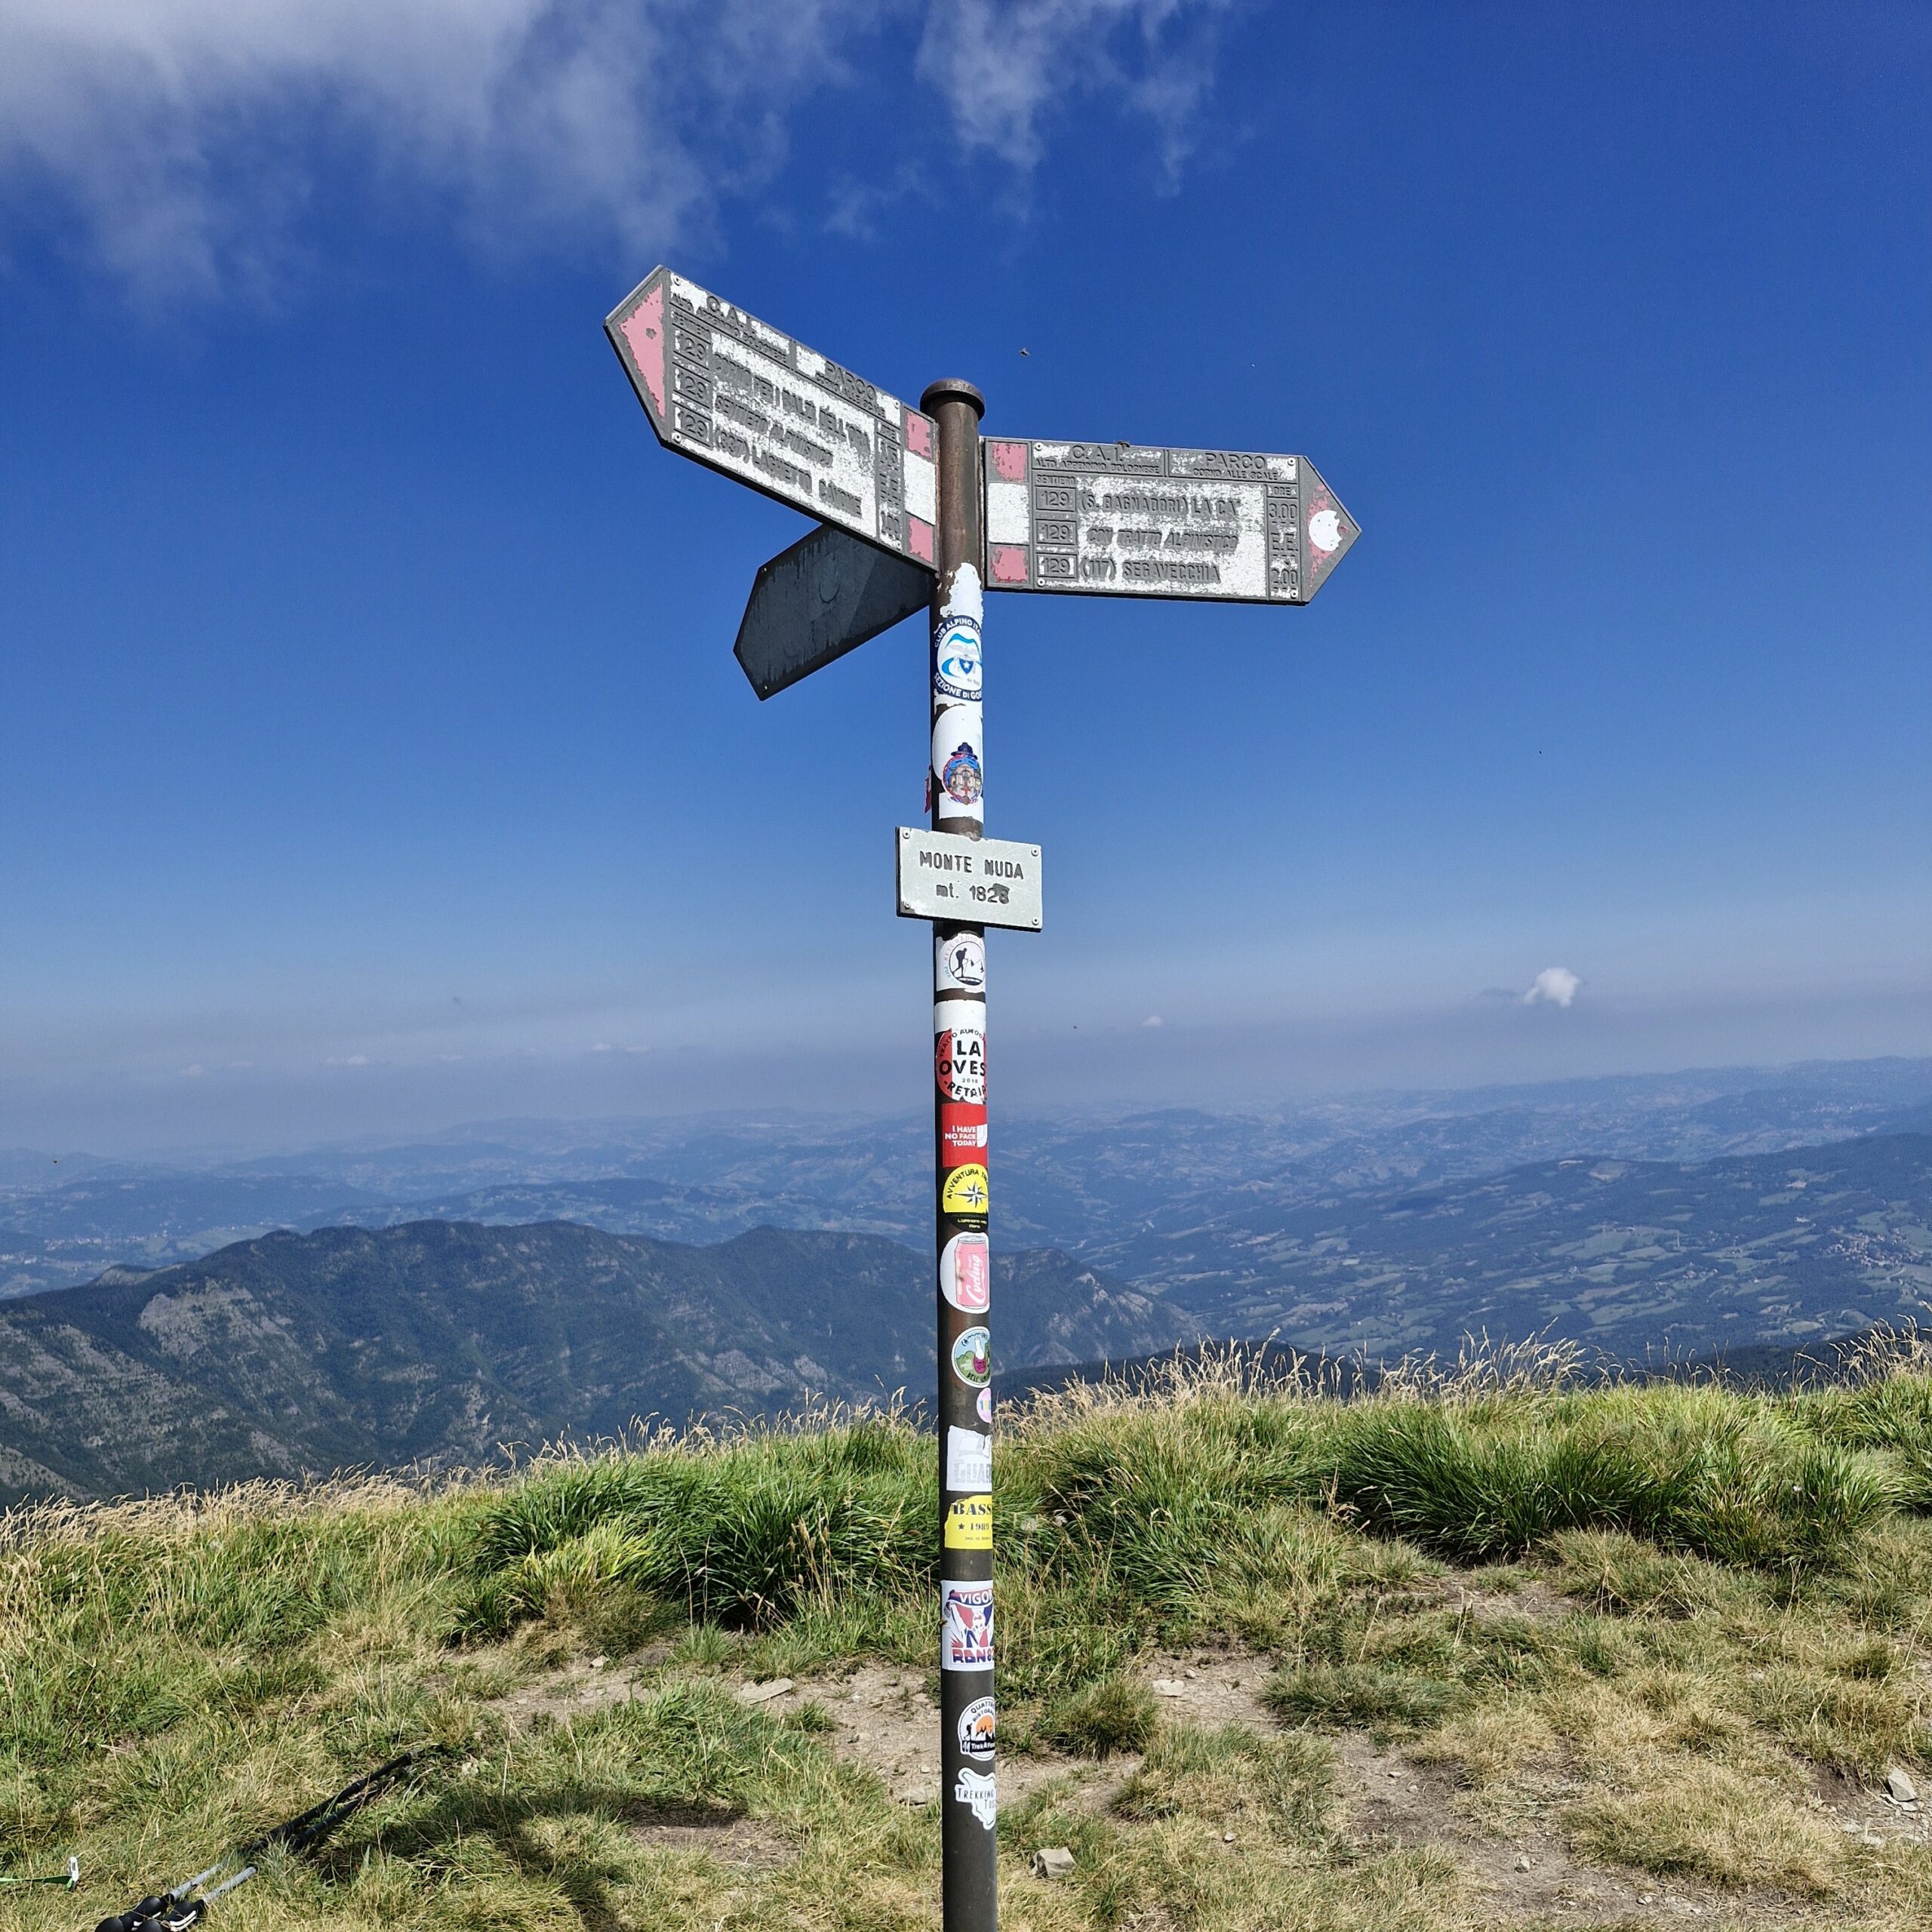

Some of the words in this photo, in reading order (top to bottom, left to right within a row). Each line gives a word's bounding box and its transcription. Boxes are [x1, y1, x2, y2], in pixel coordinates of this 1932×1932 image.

[679, 333, 706, 361] 129
[679, 371, 707, 400] 129
[825, 360, 876, 400] PARCO
[679, 410, 707, 438] 129
[1072, 445, 1124, 463] C.A.I.
[1204, 452, 1267, 469] PARCO
[1036, 458, 1057, 469] ALTO
[1061, 460, 1107, 472] APPENNINO
[1110, 463, 1160, 474] BOLOGNESE
[1192, 467, 1222, 478] CORNO
[1226, 469, 1246, 479] ALLE
[1251, 470, 1279, 481] SCALE
[1036, 474, 1076, 488] SENTIERO
[1041, 490, 1070, 507] 129
[1273, 486, 1292, 497] ORE
[1268, 502, 1298, 521] 3.00
[1041, 523, 1071, 541] 129
[1088, 528, 1114, 545] CON
[1117, 529, 1163, 546] TRATTO
[1164, 532, 1239, 550] ALPINISTICO
[1043, 557, 1071, 574] 129
[1122, 561, 1221, 585] SEGAVECCHIA
[934, 627, 947, 648] CLUB
[946, 617, 973, 630] ALPINO
[934, 672, 962, 697] SEZIONE
[919, 851, 972, 874] MONTE
[984, 859, 1024, 880] NUDA
[936, 882, 959, 899] mt.
[956, 1040, 981, 1057] LA
[956, 1124, 977, 1133] HAVE
[946, 1168, 980, 1200] AVVENTURA
[958, 1787, 994, 1799] TREKKING
